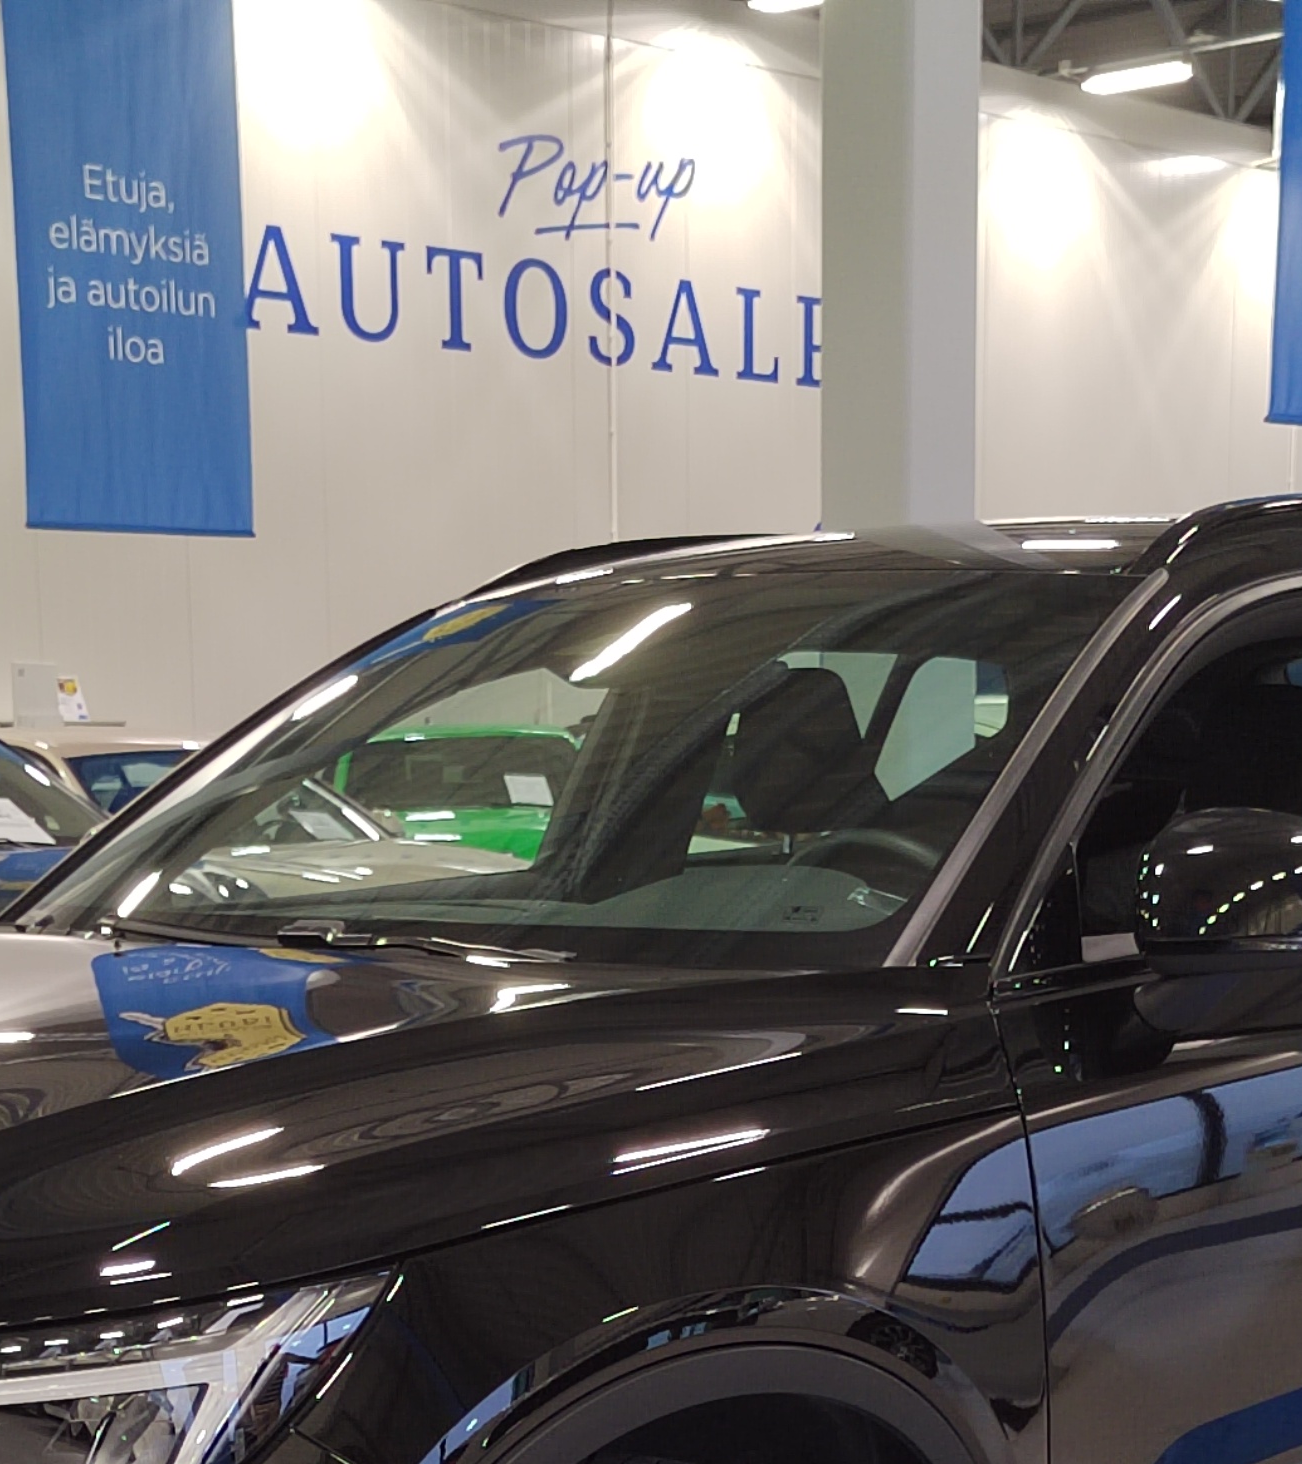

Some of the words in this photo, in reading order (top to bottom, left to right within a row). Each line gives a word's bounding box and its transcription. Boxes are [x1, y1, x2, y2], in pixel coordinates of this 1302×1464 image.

[82, 163, 174, 214] Etuja,
[498, 134, 696, 241] Pop-up
[49, 213, 209, 266] elämyksiä
[47, 264, 77, 309] ja
[87, 277, 216, 318] autoilun
[107, 325, 164, 365] iloa
